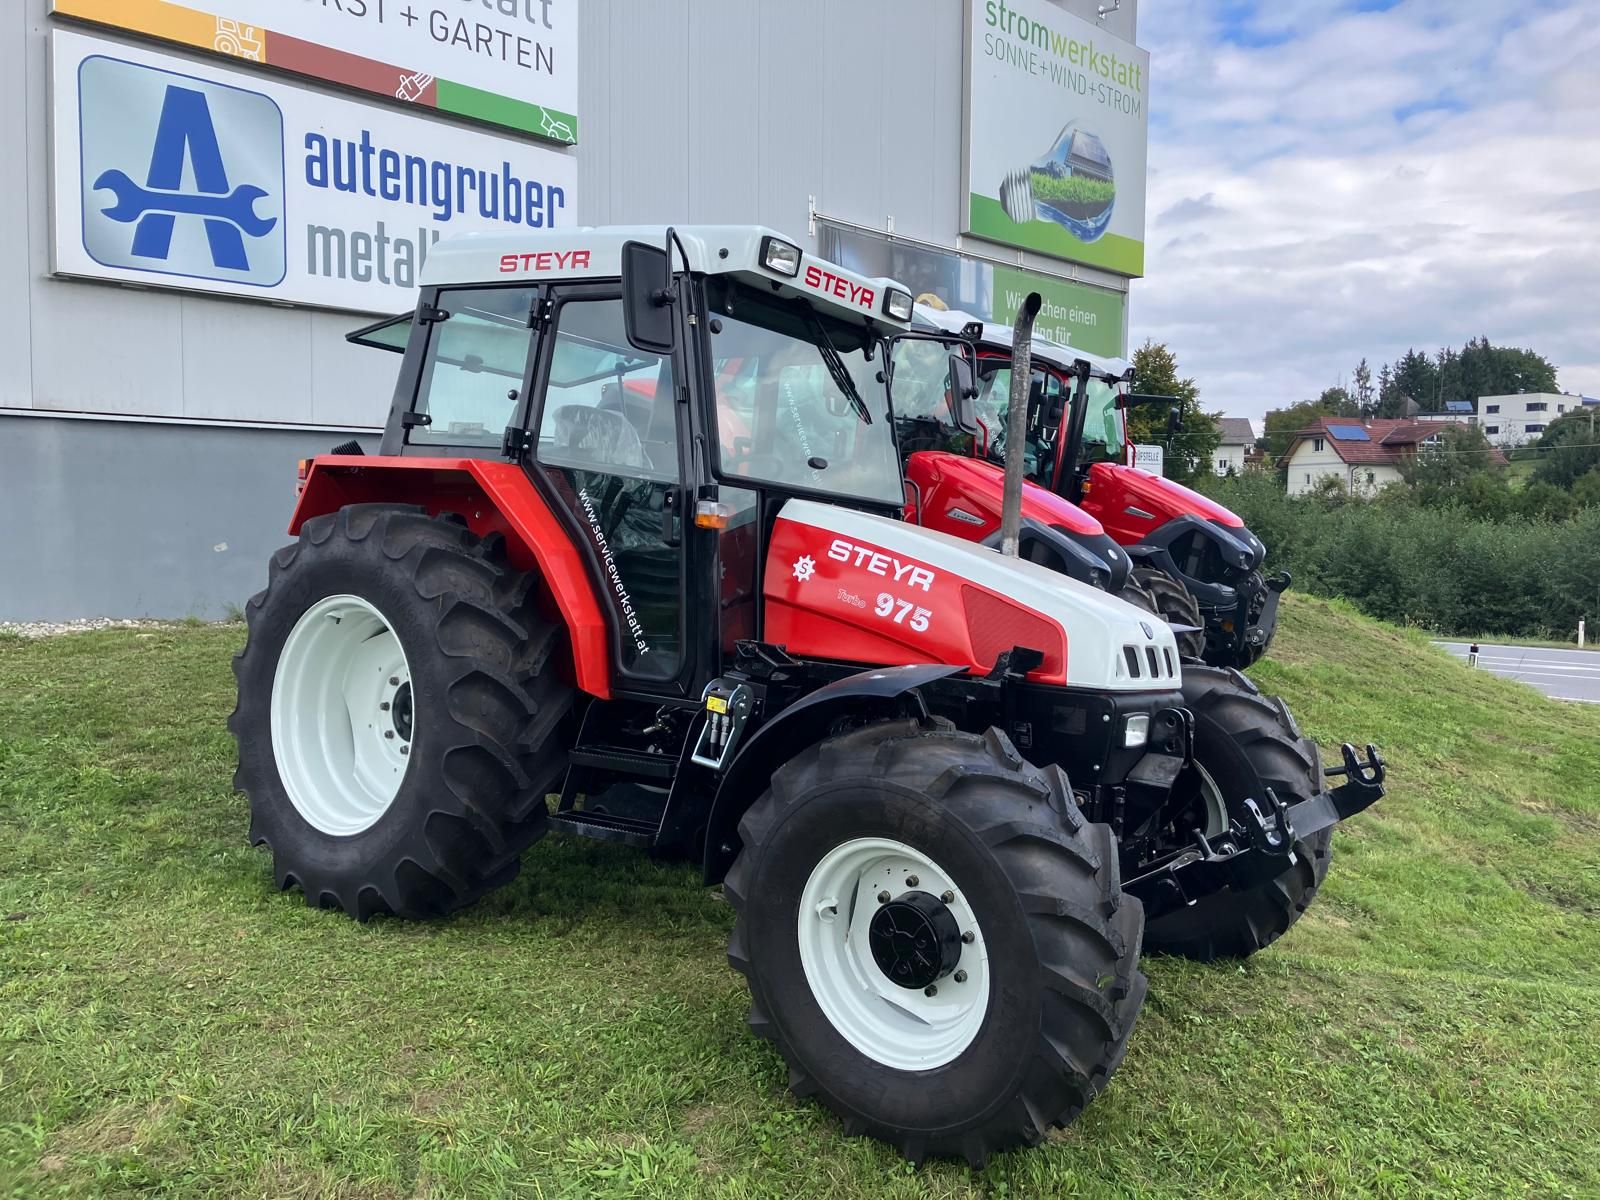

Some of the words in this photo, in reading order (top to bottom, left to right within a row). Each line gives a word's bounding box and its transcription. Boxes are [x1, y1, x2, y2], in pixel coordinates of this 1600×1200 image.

[429, 9, 553, 75] GARTEN
[985, 0, 1142, 92] stromwerkstatt
[985, 33, 1141, 119] SONNE+WIND+STROM
[304, 129, 565, 228] autengruber
[499, 250, 591, 273] STEYR
[804, 265, 875, 310] STEYR
[1055, 325, 1072, 345] für
[1069, 304, 1097, 326] einen
[578, 487, 650, 656] www.servicewerkstatt.at
[827, 539, 936, 592] STEYR
[837, 588, 867, 609] Turbo
[874, 592, 933, 632] 975
